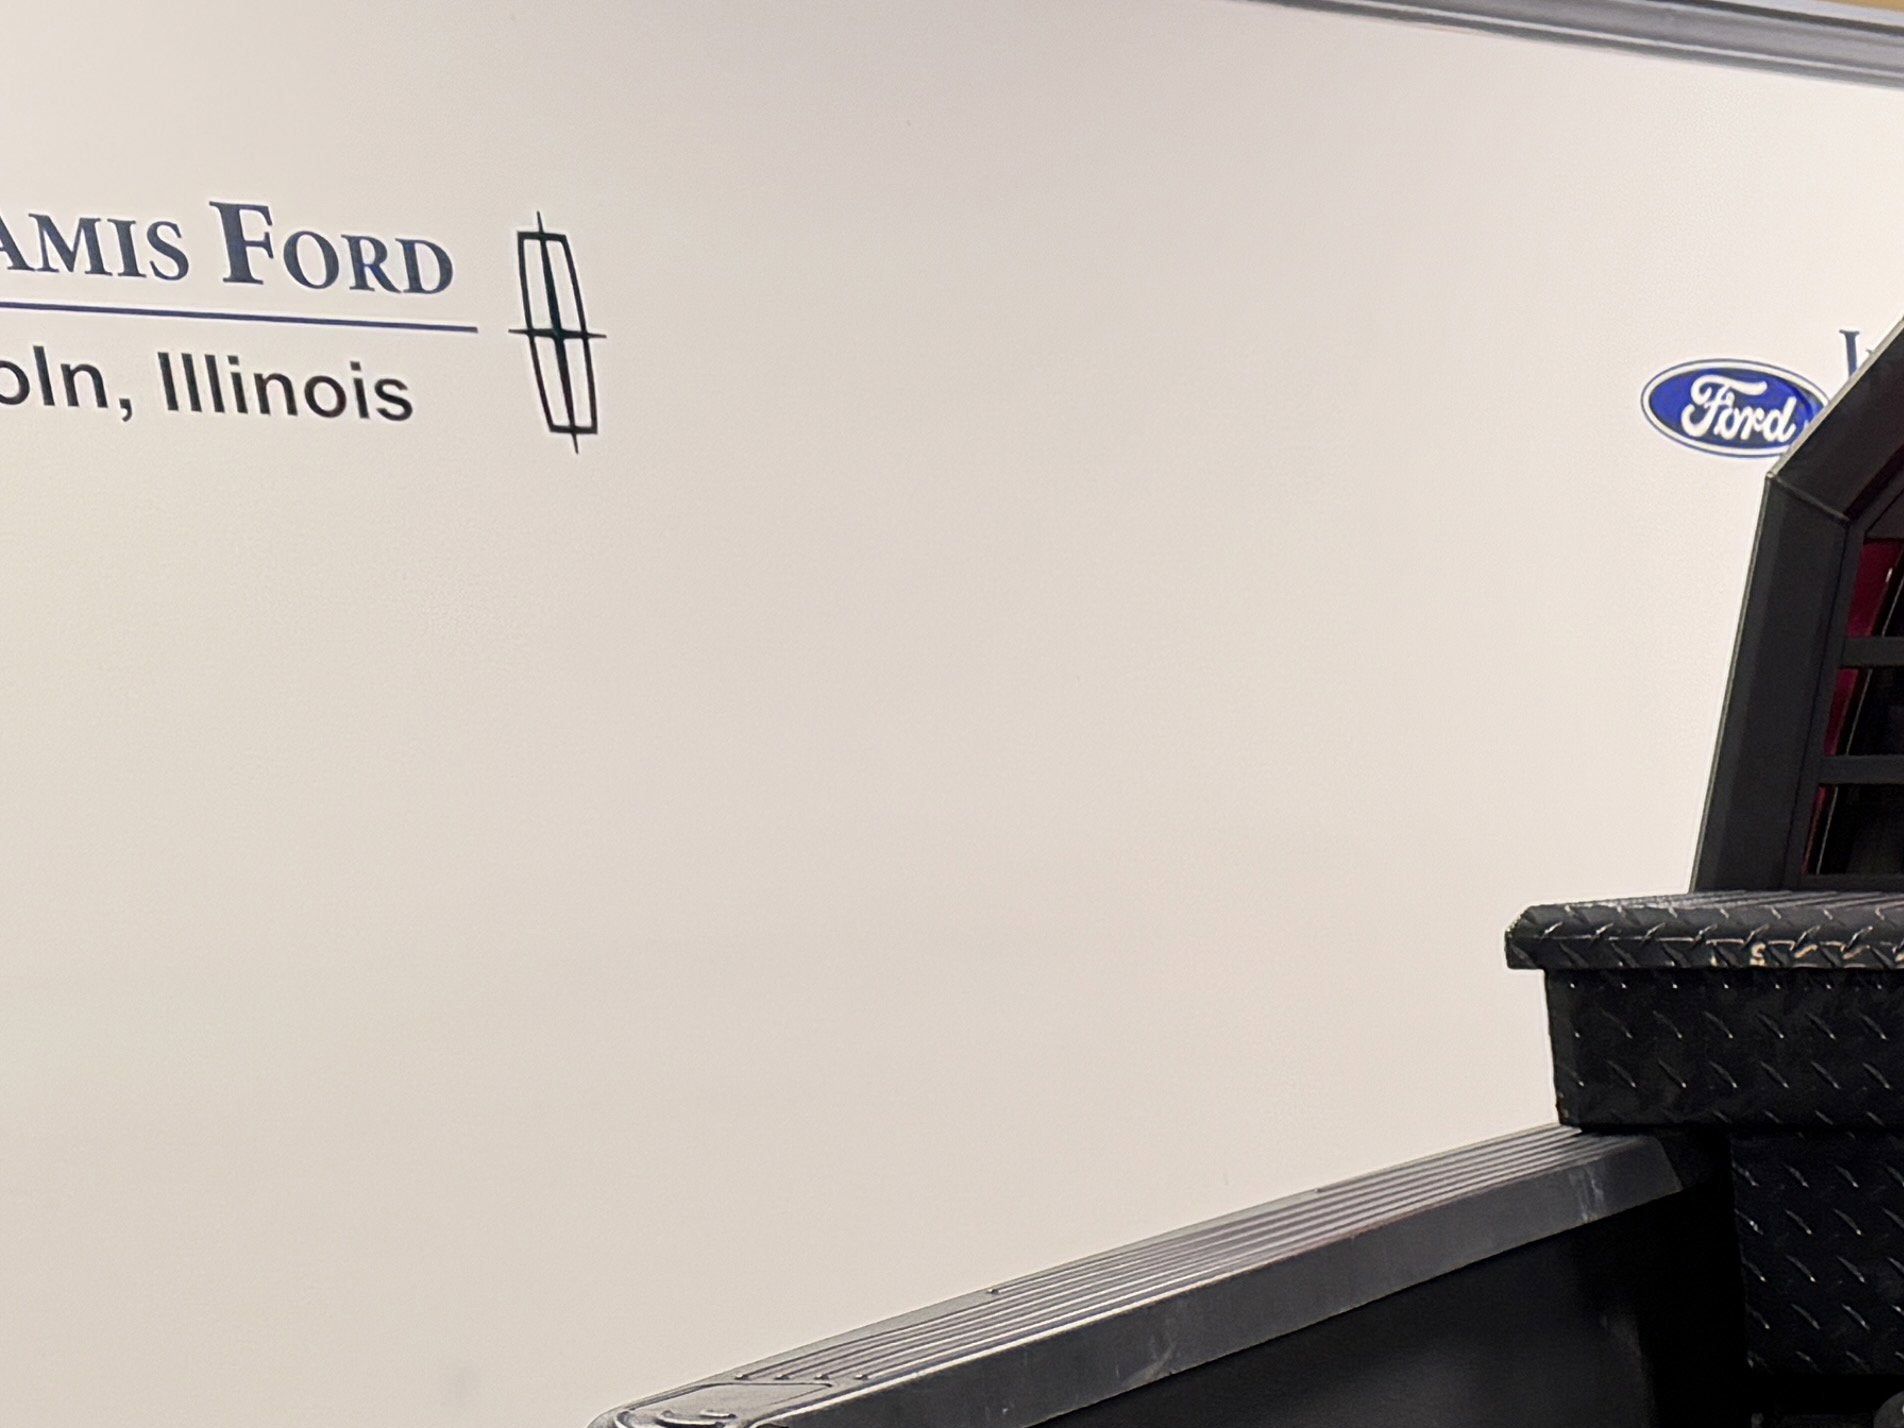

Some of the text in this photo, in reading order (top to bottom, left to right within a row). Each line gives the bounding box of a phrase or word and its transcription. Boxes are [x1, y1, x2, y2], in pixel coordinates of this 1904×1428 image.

[208, 199, 455, 297] FORD
[156, 351, 414, 423] Illinois
[1681, 373, 1798, 444] Ford
